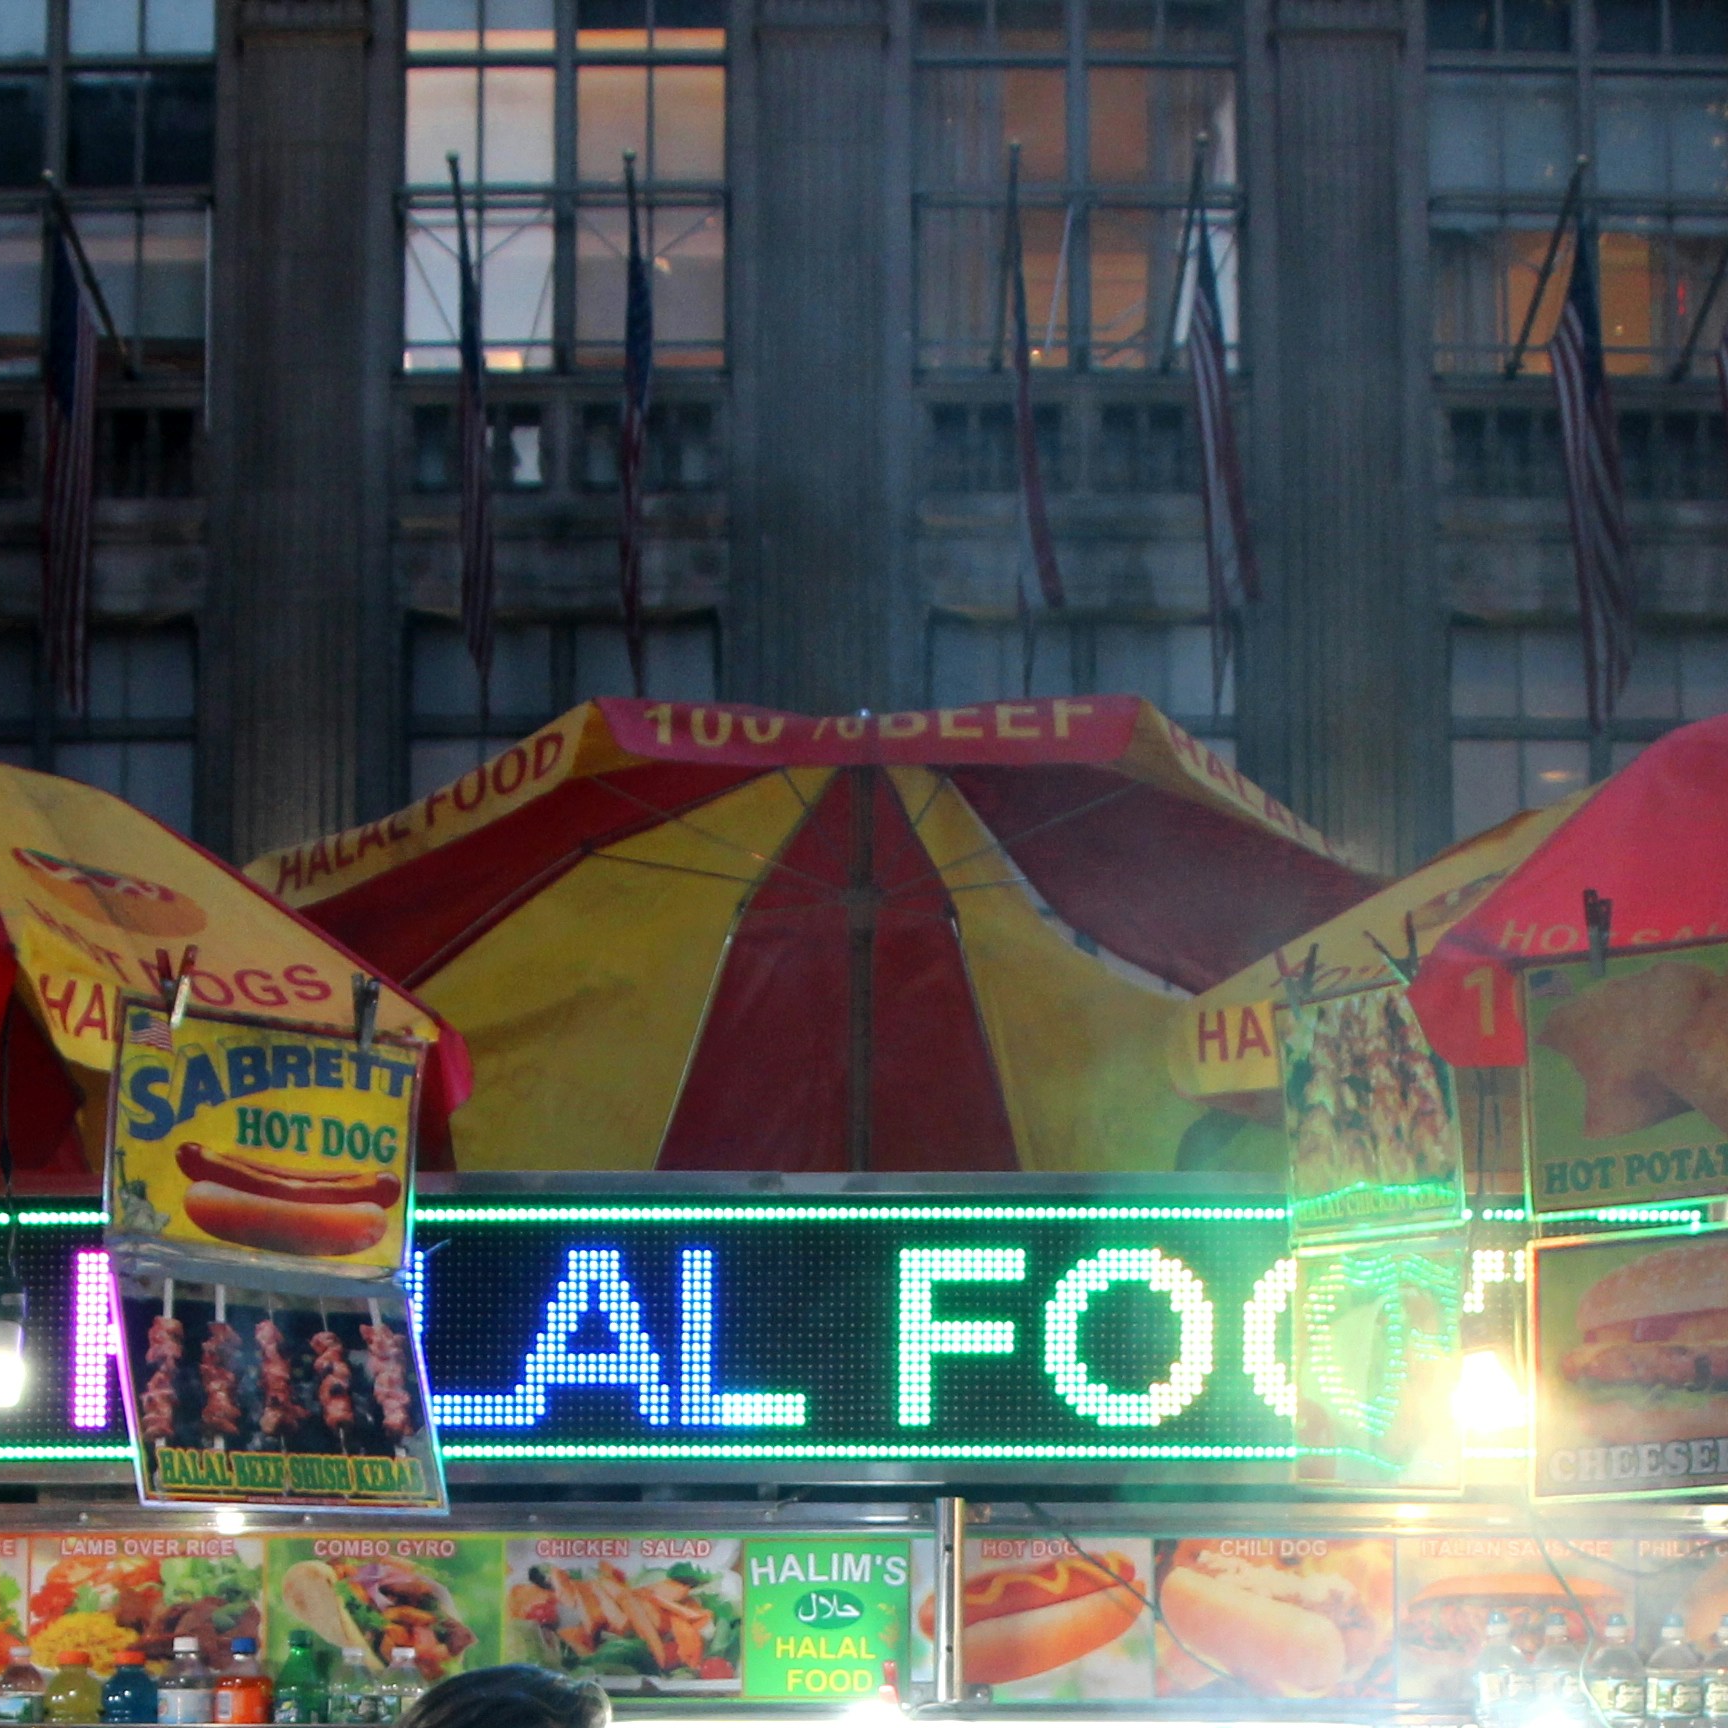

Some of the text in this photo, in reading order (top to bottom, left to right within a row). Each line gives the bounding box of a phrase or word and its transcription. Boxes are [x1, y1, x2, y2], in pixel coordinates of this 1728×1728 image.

[274, 731, 566, 897] HALAL FOOD
[128, 1045, 414, 1142] SABRETT
[236, 1107, 399, 1164] HOT DOG
[1544, 1155, 1617, 1195] HOT
[159, 1449, 427, 1496] HALAL BEEF SHISH KEBAB
[60, 1538, 235, 1557] LAMB OVER RICE
[313, 1539, 456, 1558] COMBO GYRO
[536, 1538, 712, 1557] CHICKEN SALAD
[982, 1539, 1078, 1558] HOT DOG
[1219, 1539, 1328, 1558] CHILI DOG
[1420, 1539, 1501, 1558] ITALIAN
[749, 1551, 910, 1588] HALIM'S
[775, 1635, 877, 1661] HALAL
[786, 1668, 874, 1694] FOOD
